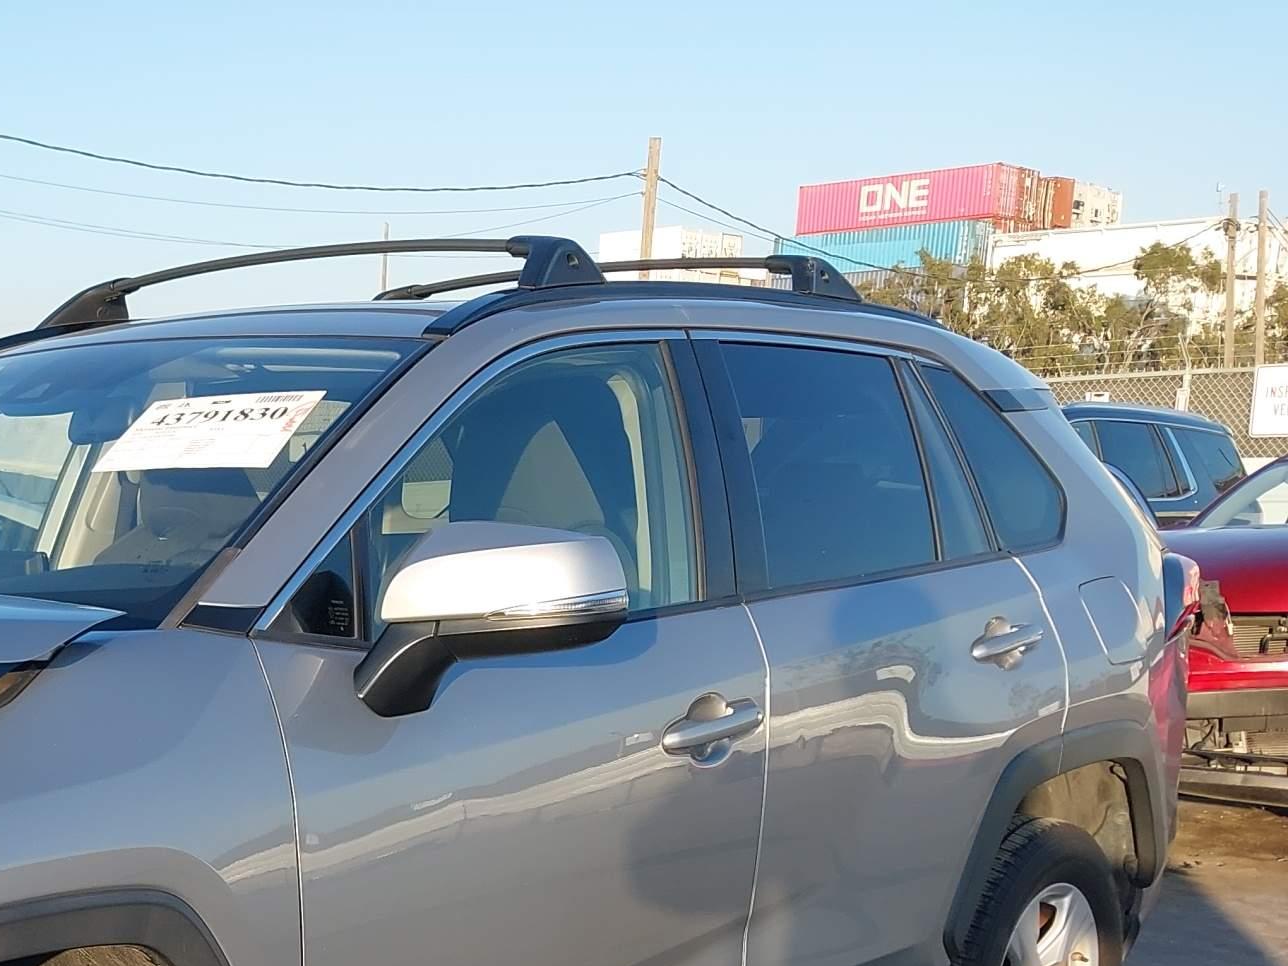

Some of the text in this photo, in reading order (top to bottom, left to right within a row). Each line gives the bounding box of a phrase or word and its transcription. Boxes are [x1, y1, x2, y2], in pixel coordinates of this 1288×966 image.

[859, 178, 930, 213] ONE
[151, 406, 289, 427] 43791830
[1273, 403, 1288, 417] VE
